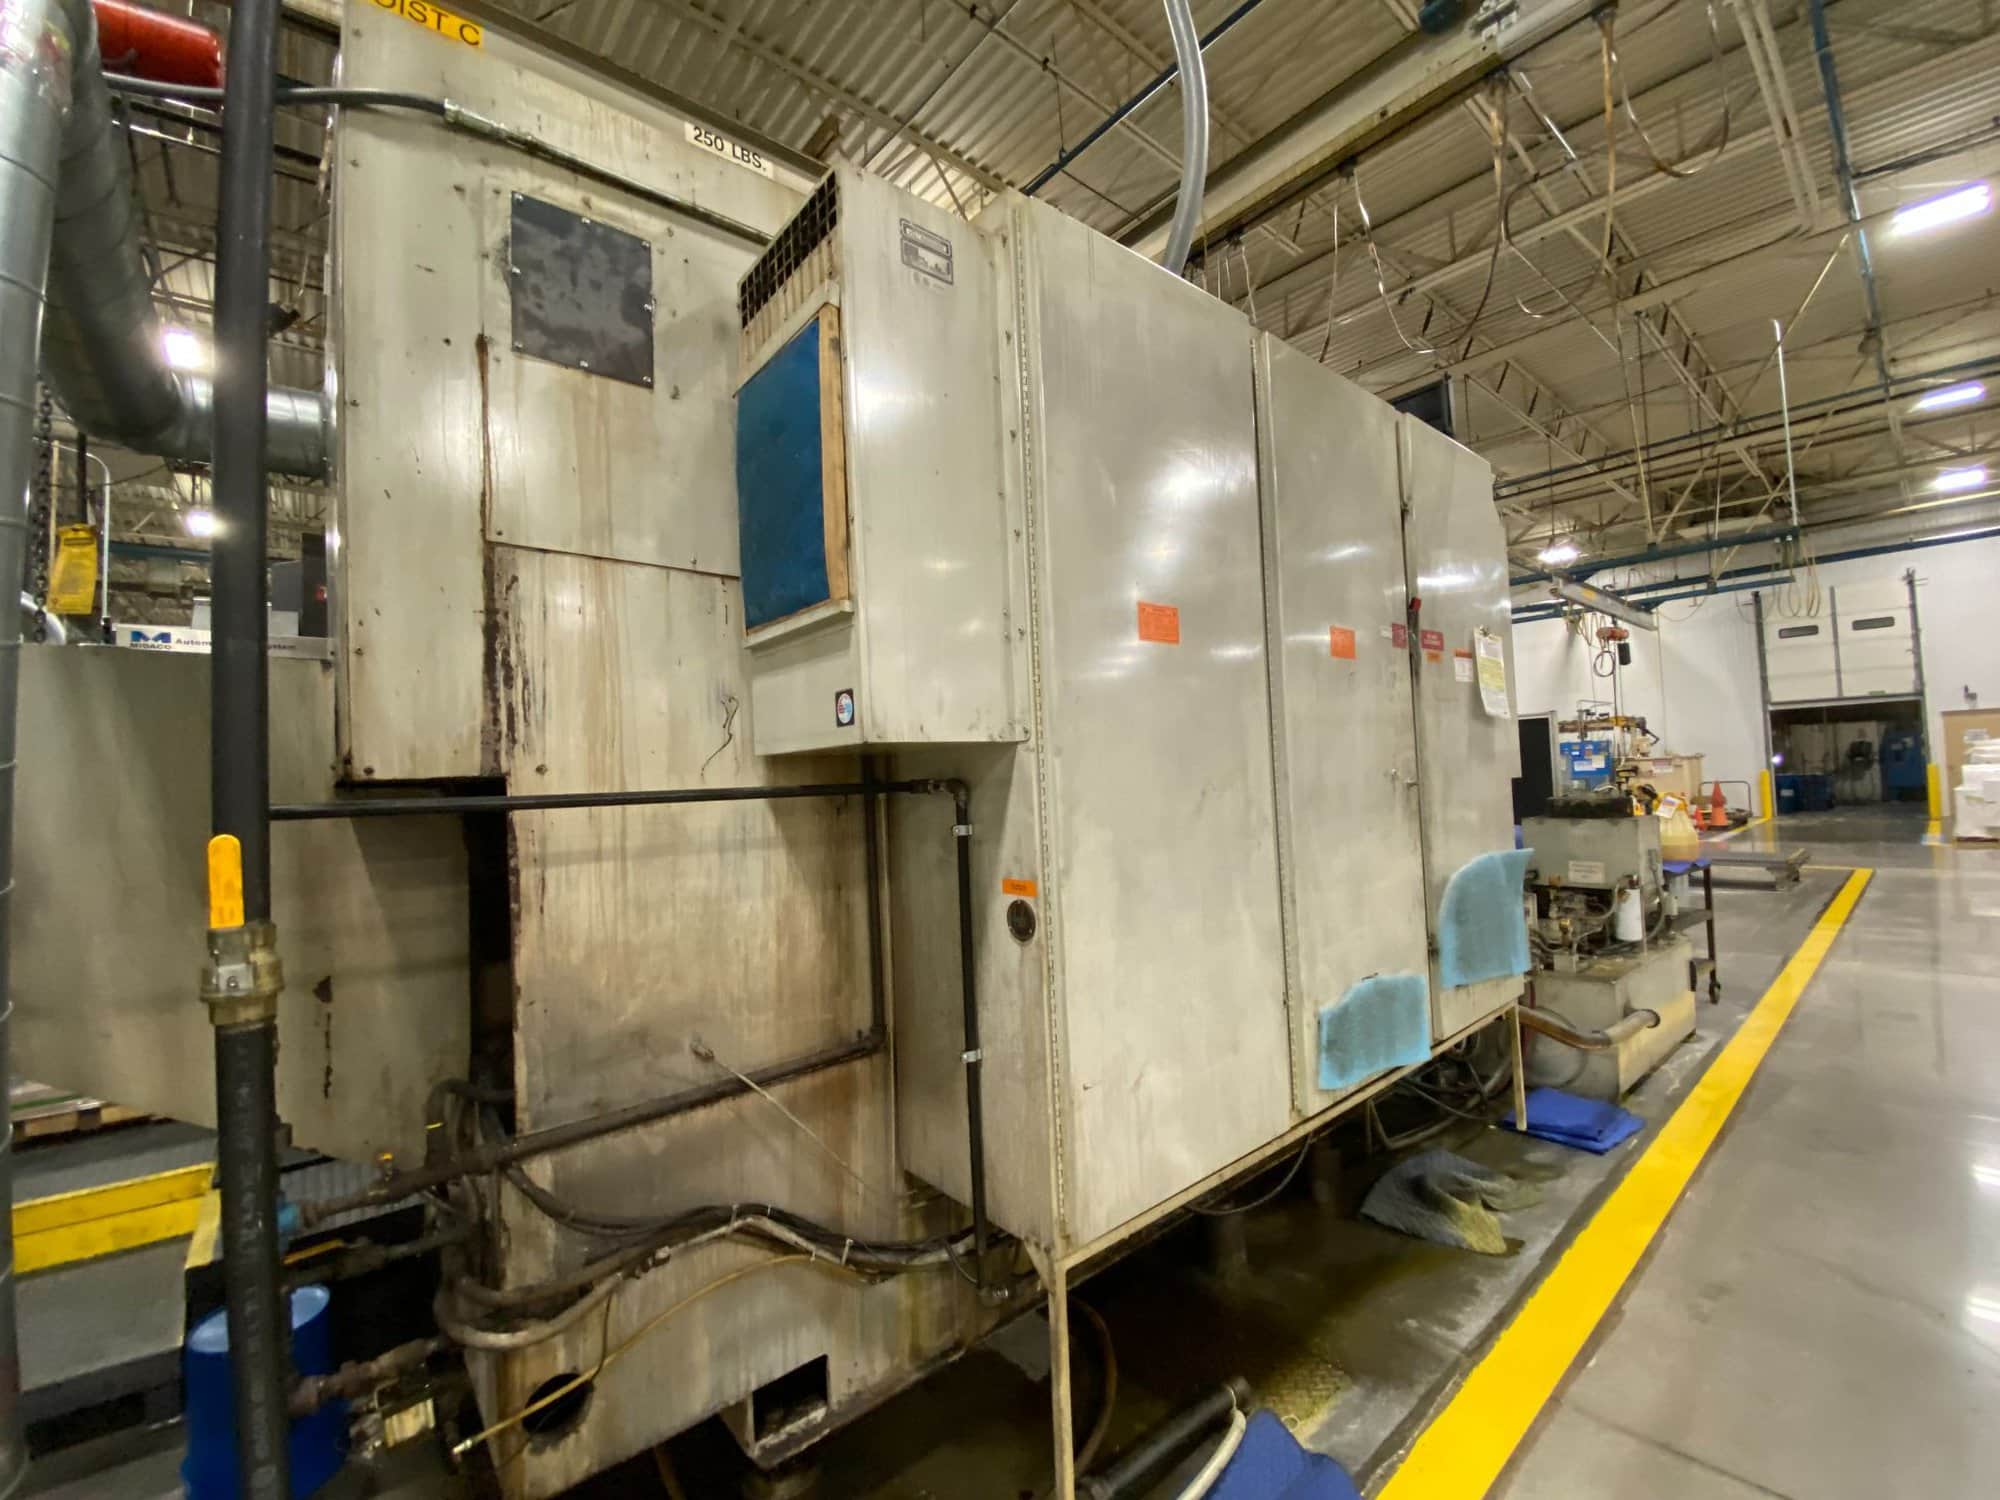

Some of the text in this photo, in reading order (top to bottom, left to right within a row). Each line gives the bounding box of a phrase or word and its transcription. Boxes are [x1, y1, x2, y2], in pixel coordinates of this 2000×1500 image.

[459, 23, 480, 46] C
[693, 126, 767, 172] 250 LBS.
[175, 638, 211, 647] Autom
